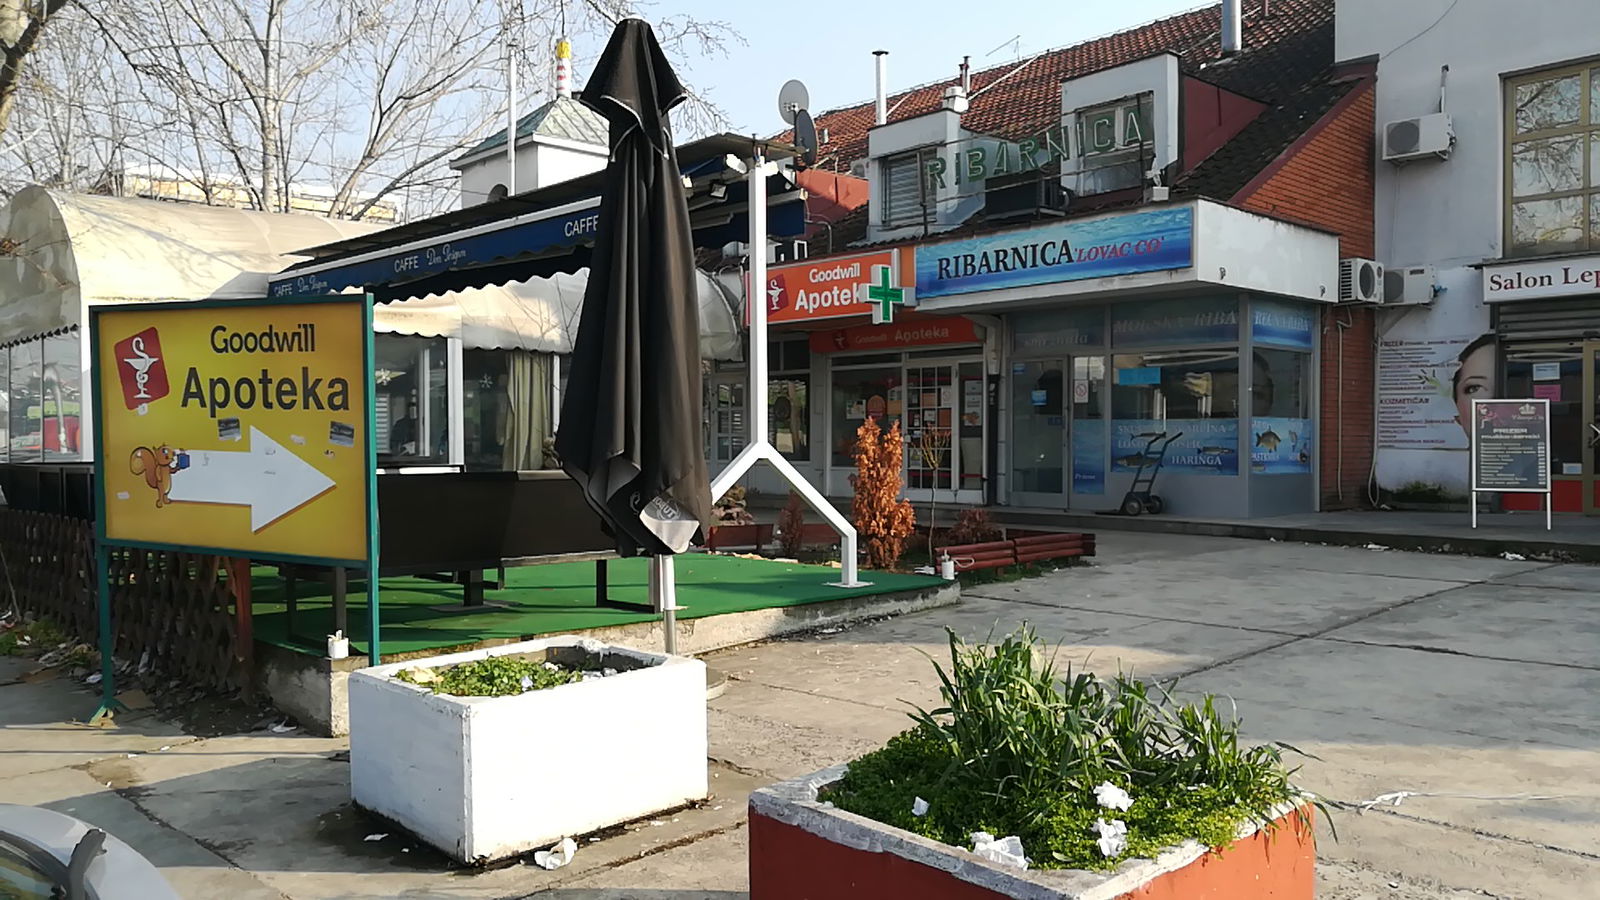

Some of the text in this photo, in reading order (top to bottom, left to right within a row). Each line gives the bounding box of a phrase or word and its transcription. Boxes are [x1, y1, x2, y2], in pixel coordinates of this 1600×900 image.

[925, 111, 1143, 190] RIBARNICA
[273, 282, 293, 297] CAFFE
[394, 255, 419, 272] CAFFE
[426, 247, 442, 265] Don
[808, 263, 861, 284] Goodwill
[937, 239, 1074, 281] RIBARNICA
[1489, 271, 1553, 291] Salon
[210, 323, 316, 354] Goodwill
[894, 326, 949, 342] Apoteka
[181, 366, 350, 418] Apoteka
[1171, 455, 1223, 465] HARINGA
